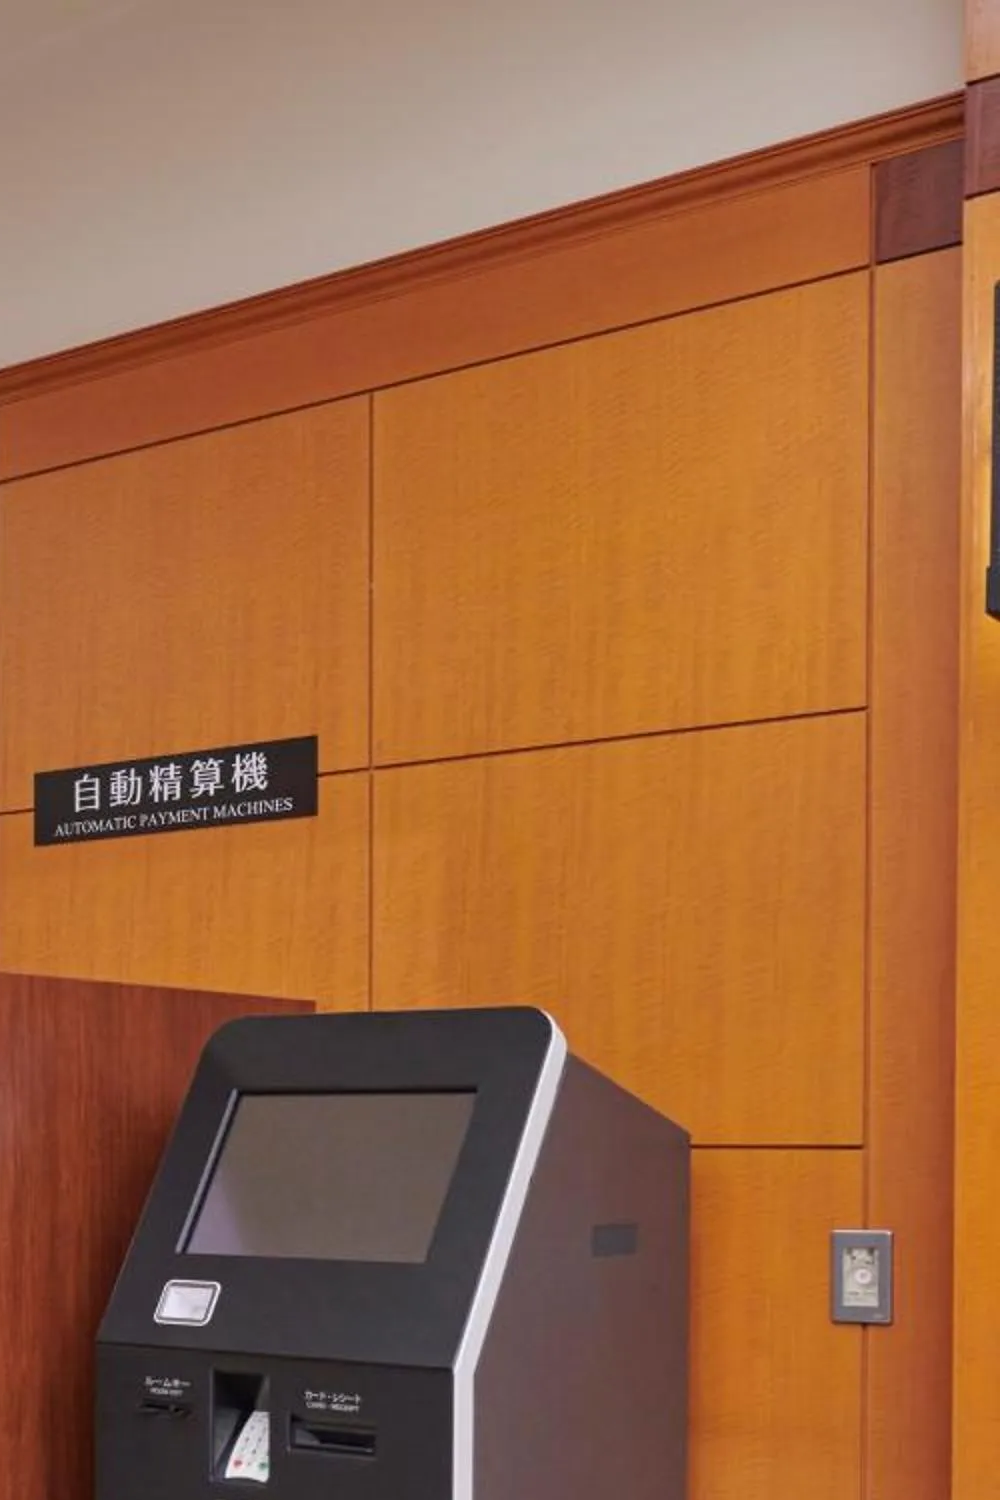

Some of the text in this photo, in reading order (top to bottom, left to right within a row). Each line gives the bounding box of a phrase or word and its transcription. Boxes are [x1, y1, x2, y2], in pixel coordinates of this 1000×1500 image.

[73, 750, 269, 813] 自動精算機
[54, 797, 293, 837] AUTOMATIC PAYMENT MACHINES
